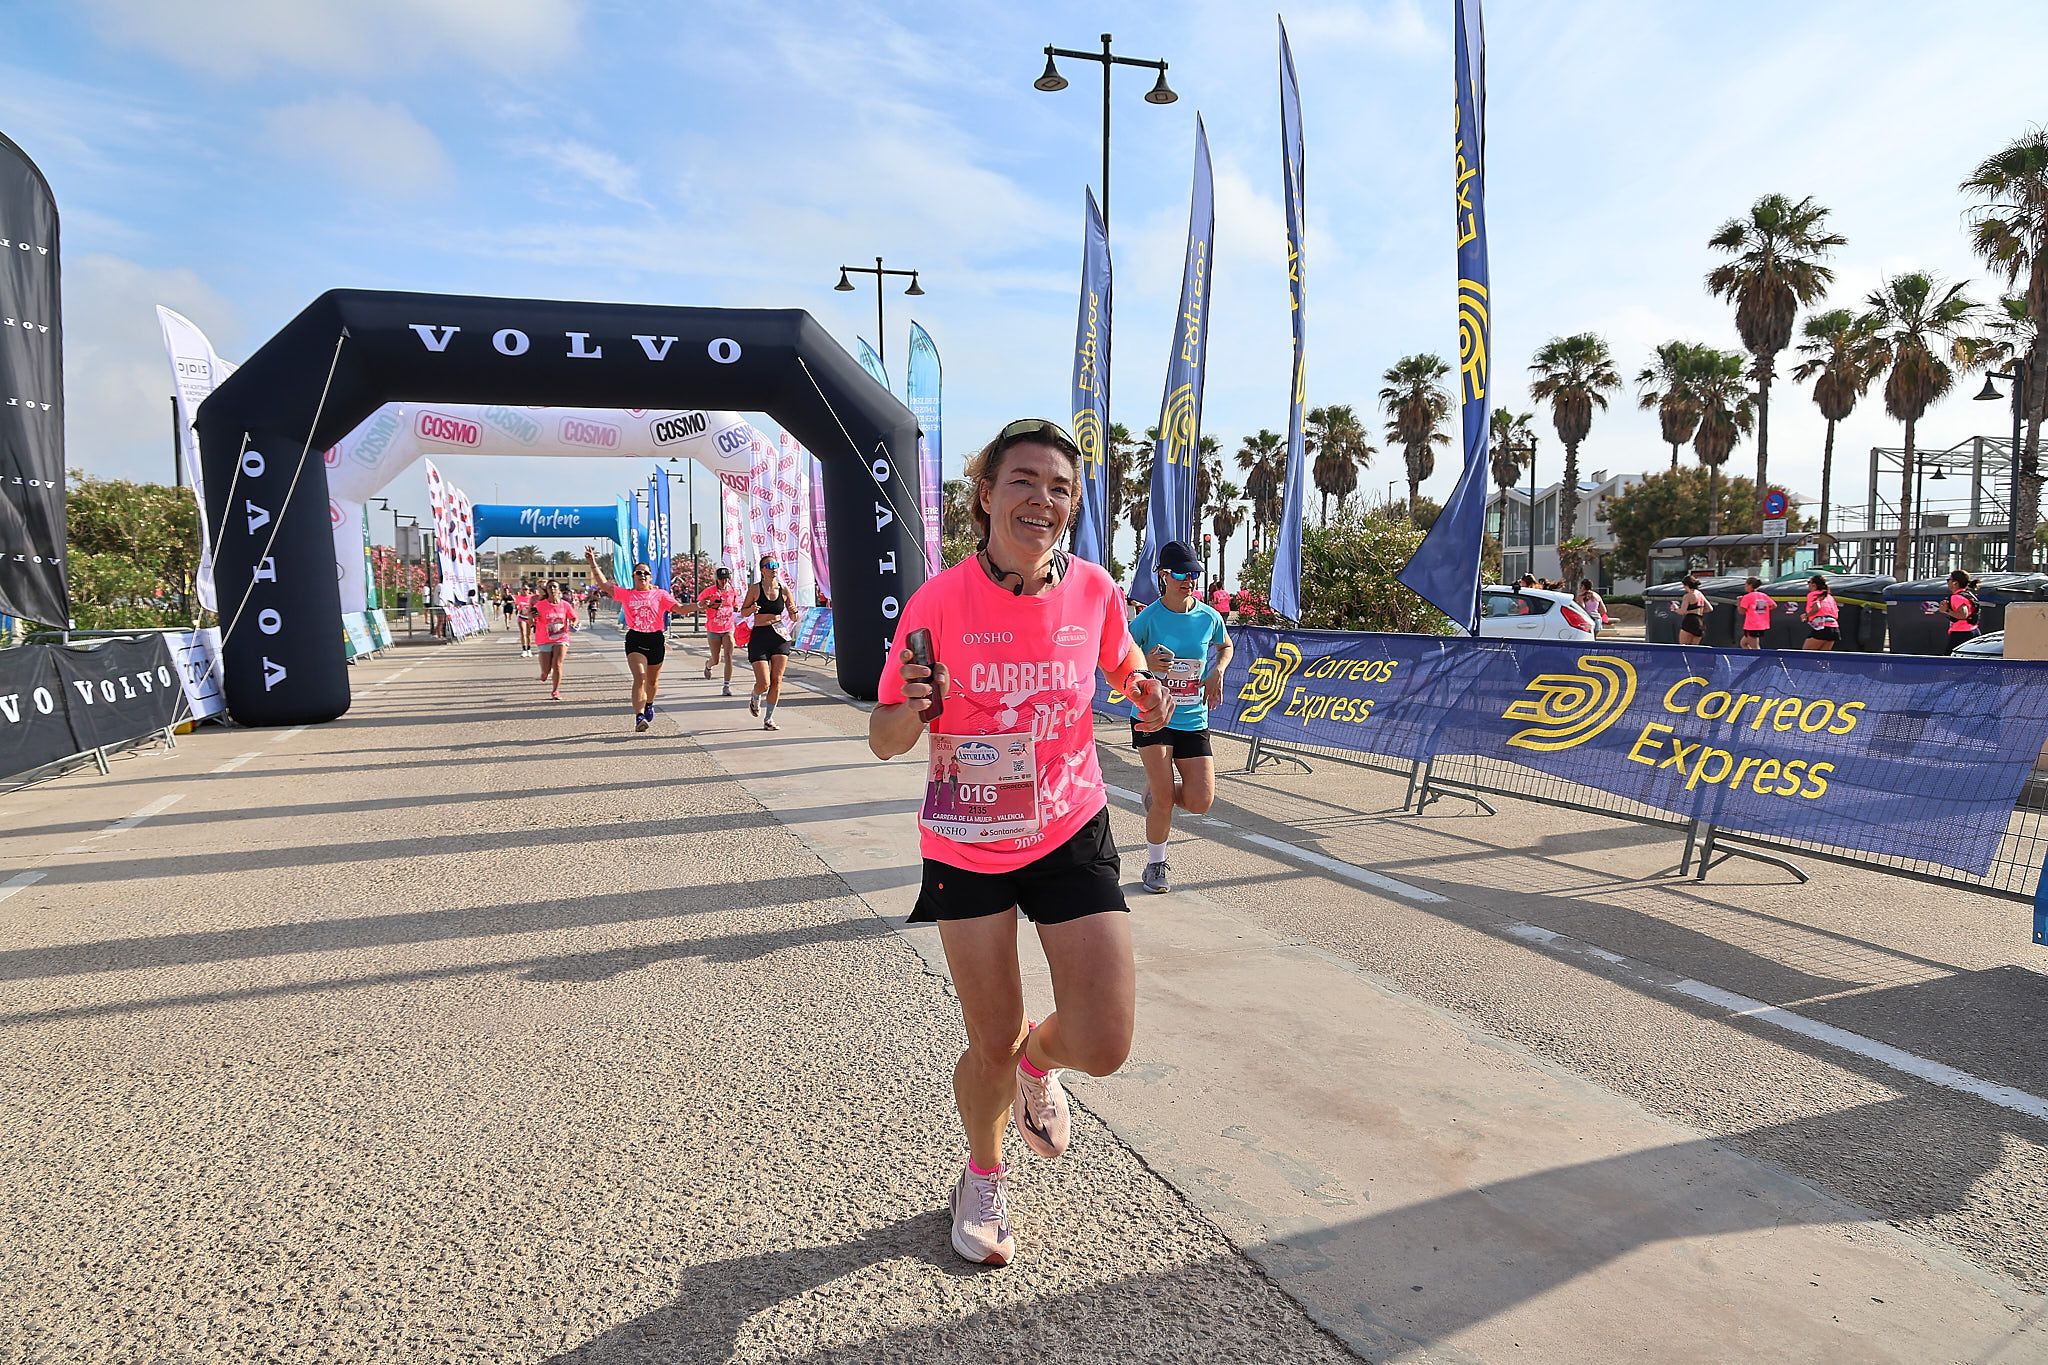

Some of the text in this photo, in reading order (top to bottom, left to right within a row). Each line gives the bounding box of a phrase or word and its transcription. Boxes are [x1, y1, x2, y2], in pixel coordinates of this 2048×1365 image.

[408, 323, 743, 364] VOLVO
[355, 413, 400, 464] COSMO
[421, 415, 477, 444] COSMO
[564, 420, 617, 447] COSMO
[656, 412, 706, 442] COSMO
[520, 508, 580, 533] Marlene
[242, 450, 287, 692] VOLVO
[962, 631, 1014, 645] OYSHO
[970, 660, 1079, 693] CARRERA
[1304, 656, 1398, 683] Correos
[73, 665, 172, 705] VOLVO
[1168, 680, 1187, 688] 016
[1284, 686, 1375, 727] Express
[1663, 676, 1866, 735] Correos
[1031, 702, 1066, 742] DE
[958, 753, 996, 761] ASTURIANA
[1627, 721, 1835, 800] Express
[959, 784, 998, 803] 016
[932, 812, 958, 821] CARRERA
[958, 814, 967, 822] DE
[967, 814, 974, 822] LA
[974, 815, 993, 823] MUJER
[997, 812, 1025, 821] VALENCIA
[968, 806, 988, 815] 2135
[932, 825, 967, 837] OYSHO
[989, 828, 1026, 837] Santander
